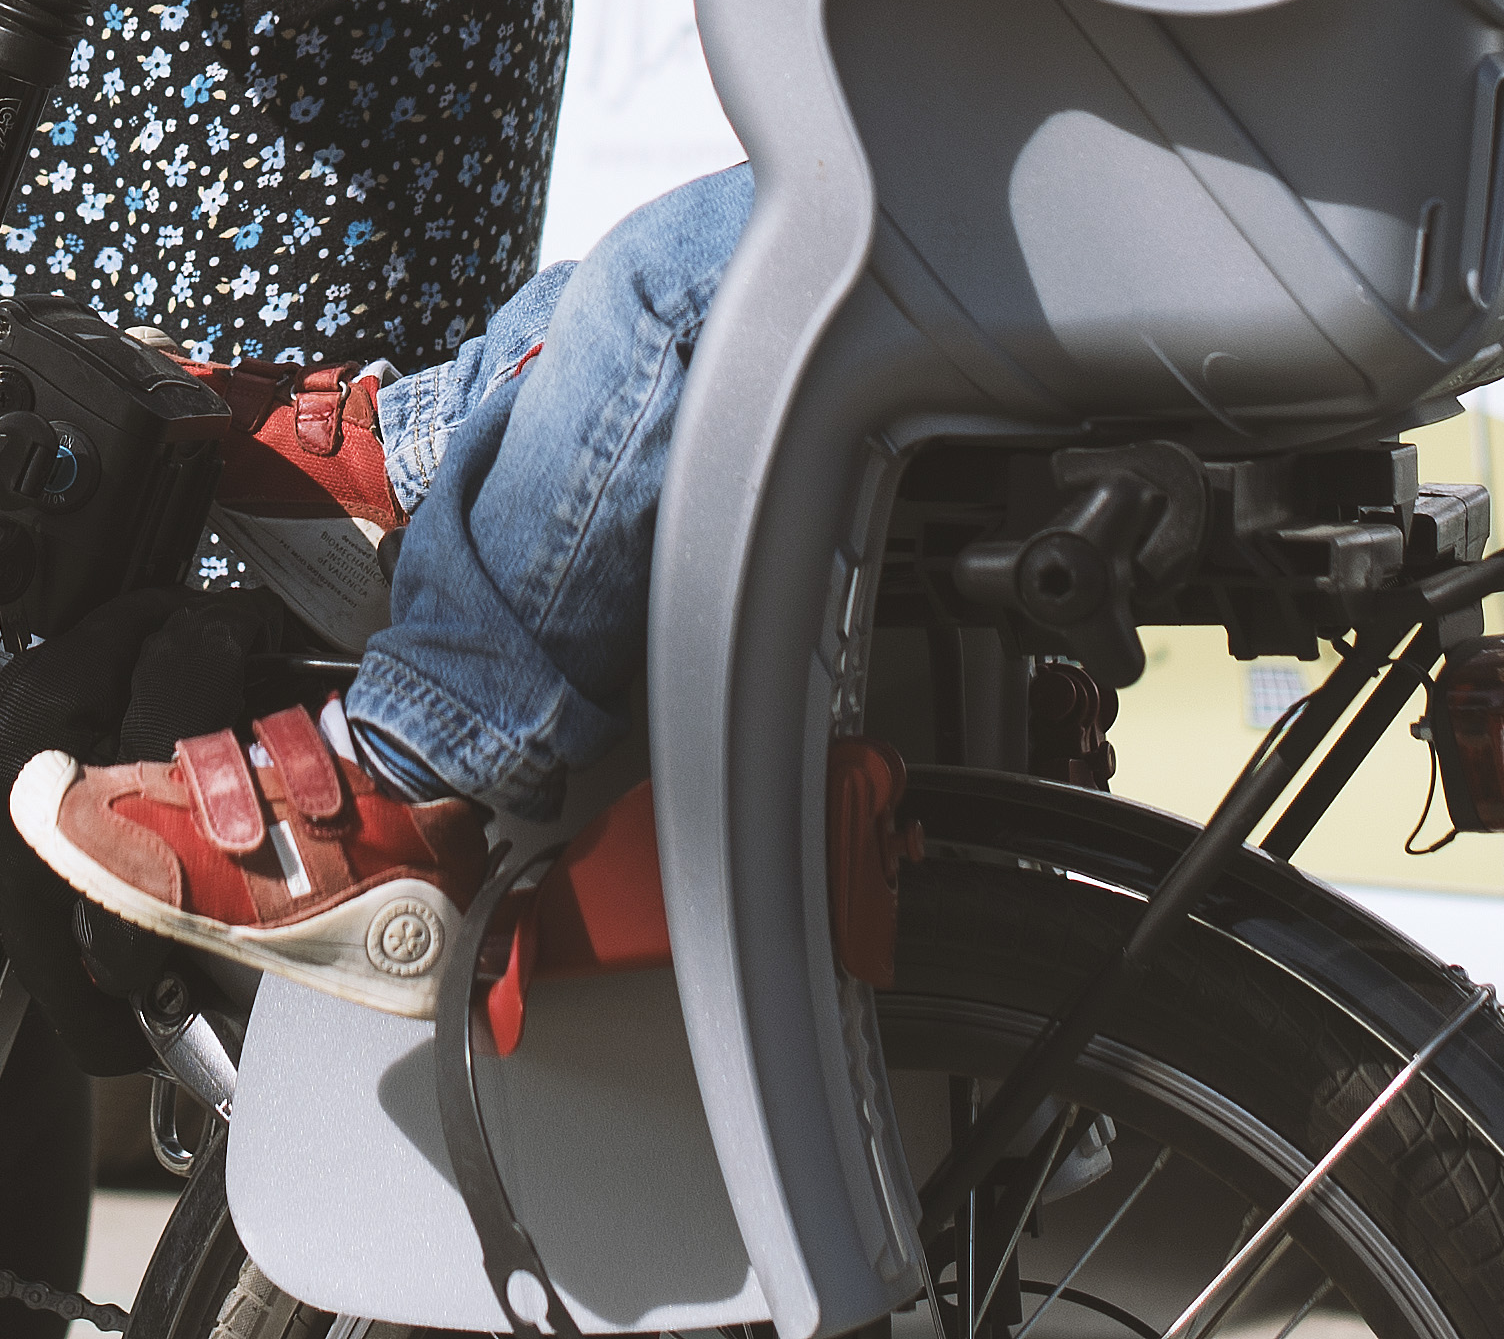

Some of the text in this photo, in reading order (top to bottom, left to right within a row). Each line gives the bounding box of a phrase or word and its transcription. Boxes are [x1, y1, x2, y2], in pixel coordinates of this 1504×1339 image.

[59, 434, 75, 450] ON
[326, 550, 371, 585] INSTITUTE
[328, 565, 367, 598] VALENCIA
